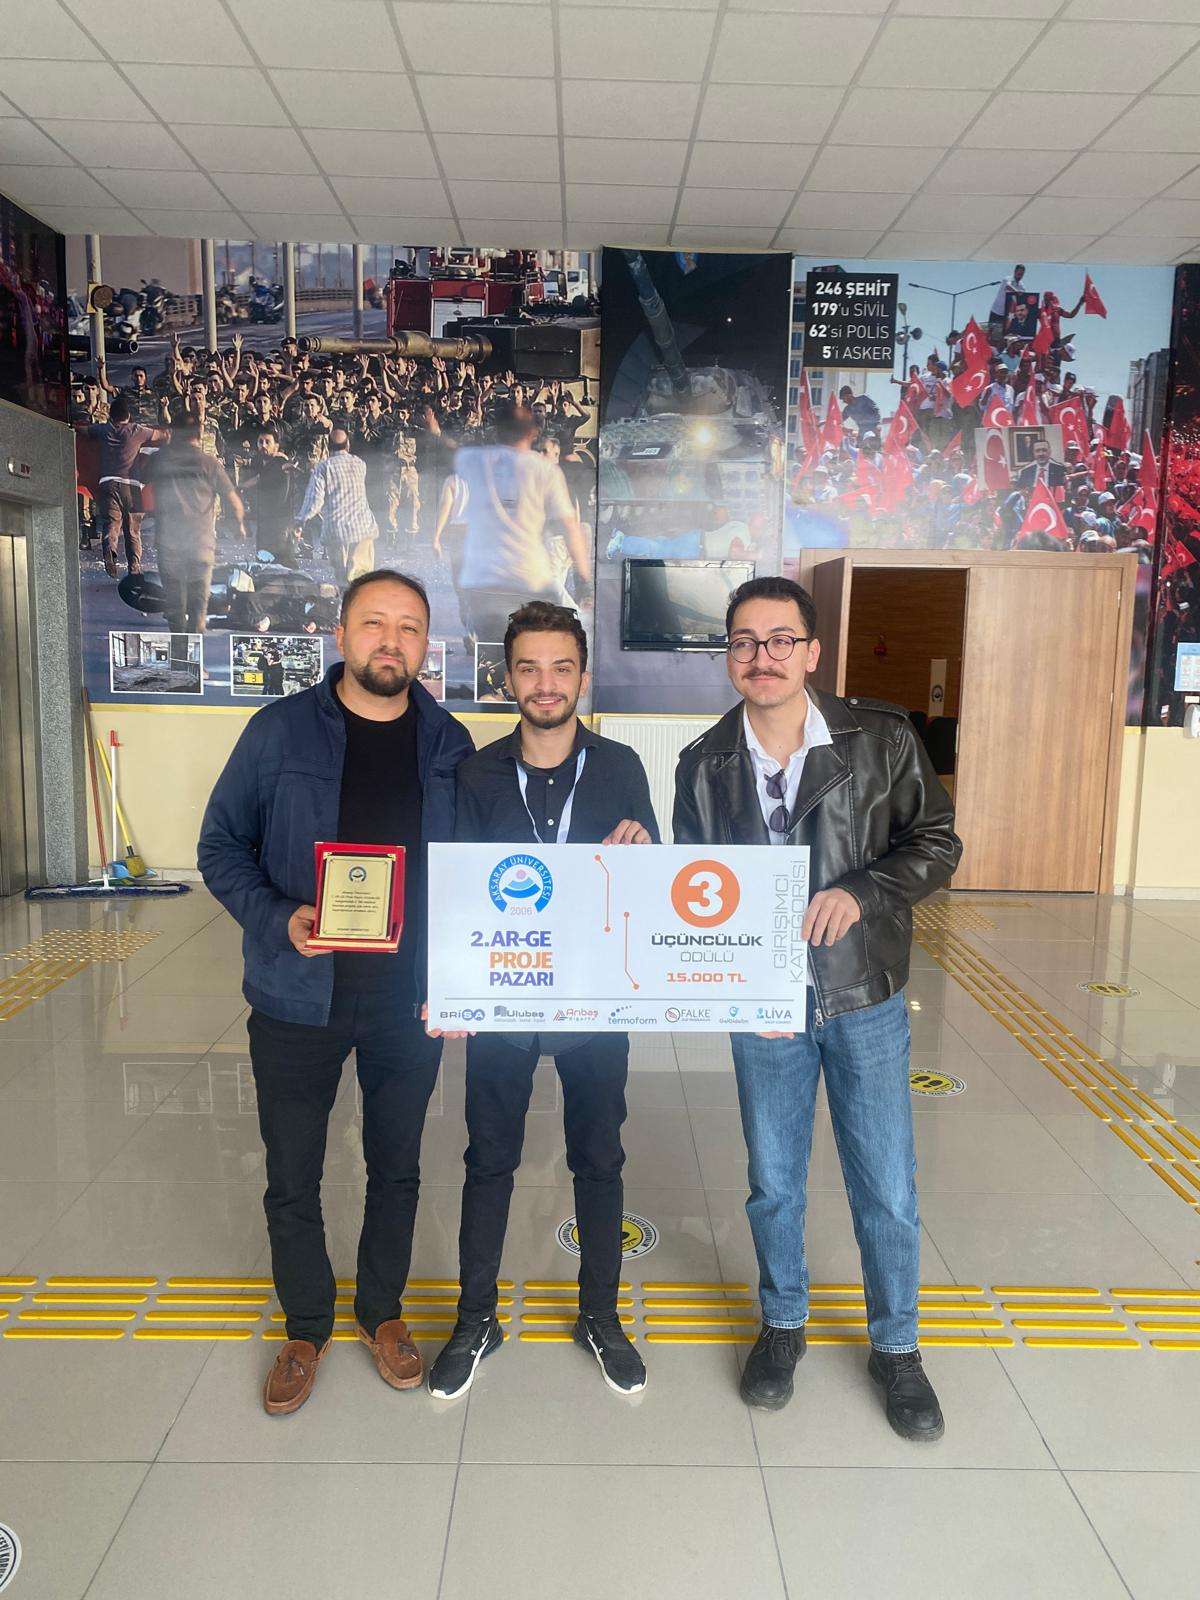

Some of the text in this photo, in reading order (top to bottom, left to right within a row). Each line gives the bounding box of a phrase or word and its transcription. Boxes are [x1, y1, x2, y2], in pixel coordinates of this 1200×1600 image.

[815, 279, 892, 299] 246 ŞEHİT
[812, 301, 890, 318] 179'u SİVİL
[809, 323, 890, 339] 62'si POLİS
[822, 345, 892, 360] 5'i ASKER
[490, 855, 552, 901] AKSARAY ÜNİVERSİTESİ
[687, 870, 724, 918] 3
[510, 906, 533, 916] 2006
[772, 874, 790, 969] GİRİŞİMCİ
[790, 859, 806, 982] KATEGORİSİ
[470, 930, 552, 947] 2.AR-GE
[651, 932, 764, 948] ÜÇÜNCÜLÜK
[489, 951, 553, 969] PROJE
[489, 971, 554, 987] PAZARI
[666, 972, 748, 983] 15.000 TL
[608, 1016, 658, 1025] termoform
[681, 1009, 711, 1018] FALKE
[765, 1006, 793, 1019] LİVA
